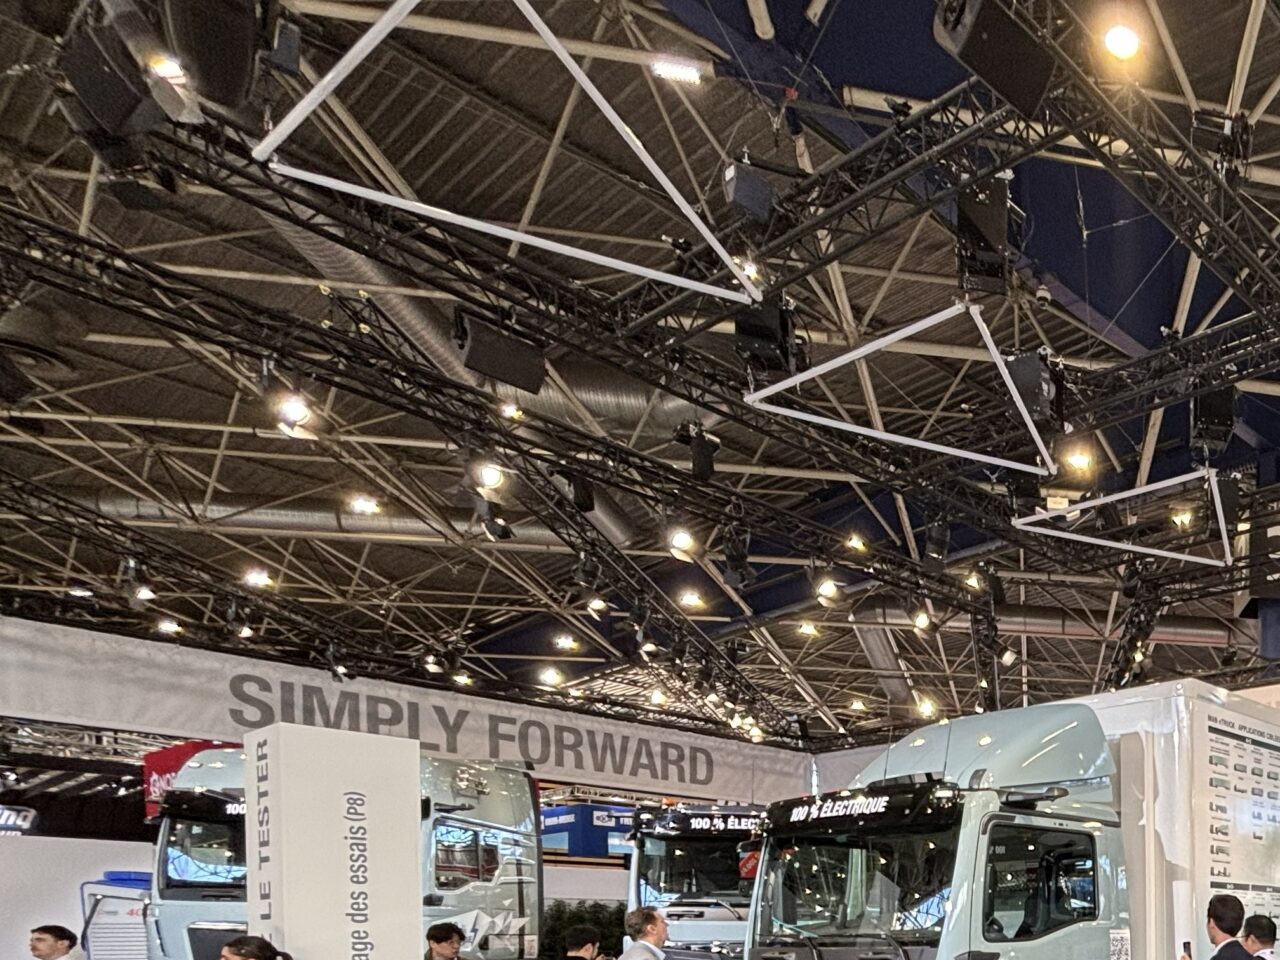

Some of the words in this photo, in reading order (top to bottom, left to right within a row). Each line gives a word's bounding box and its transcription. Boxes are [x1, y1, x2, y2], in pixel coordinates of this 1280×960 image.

[229, 673, 470, 754] SIMPLY
[488, 713, 714, 786] FORWARD
[225, 803, 246, 815] 100
[256, 738, 271, 871] TESTER
[343, 791, 367, 822] (P8)
[790, 805, 807, 823] 100
[810, 804, 822, 819] %
[822, 796, 889, 817] ÉLECTRIQUE
[690, 817, 711, 830] 100
[344, 825, 368, 885] essais
[259, 881, 272, 921] LE
[345, 890, 369, 925] des
